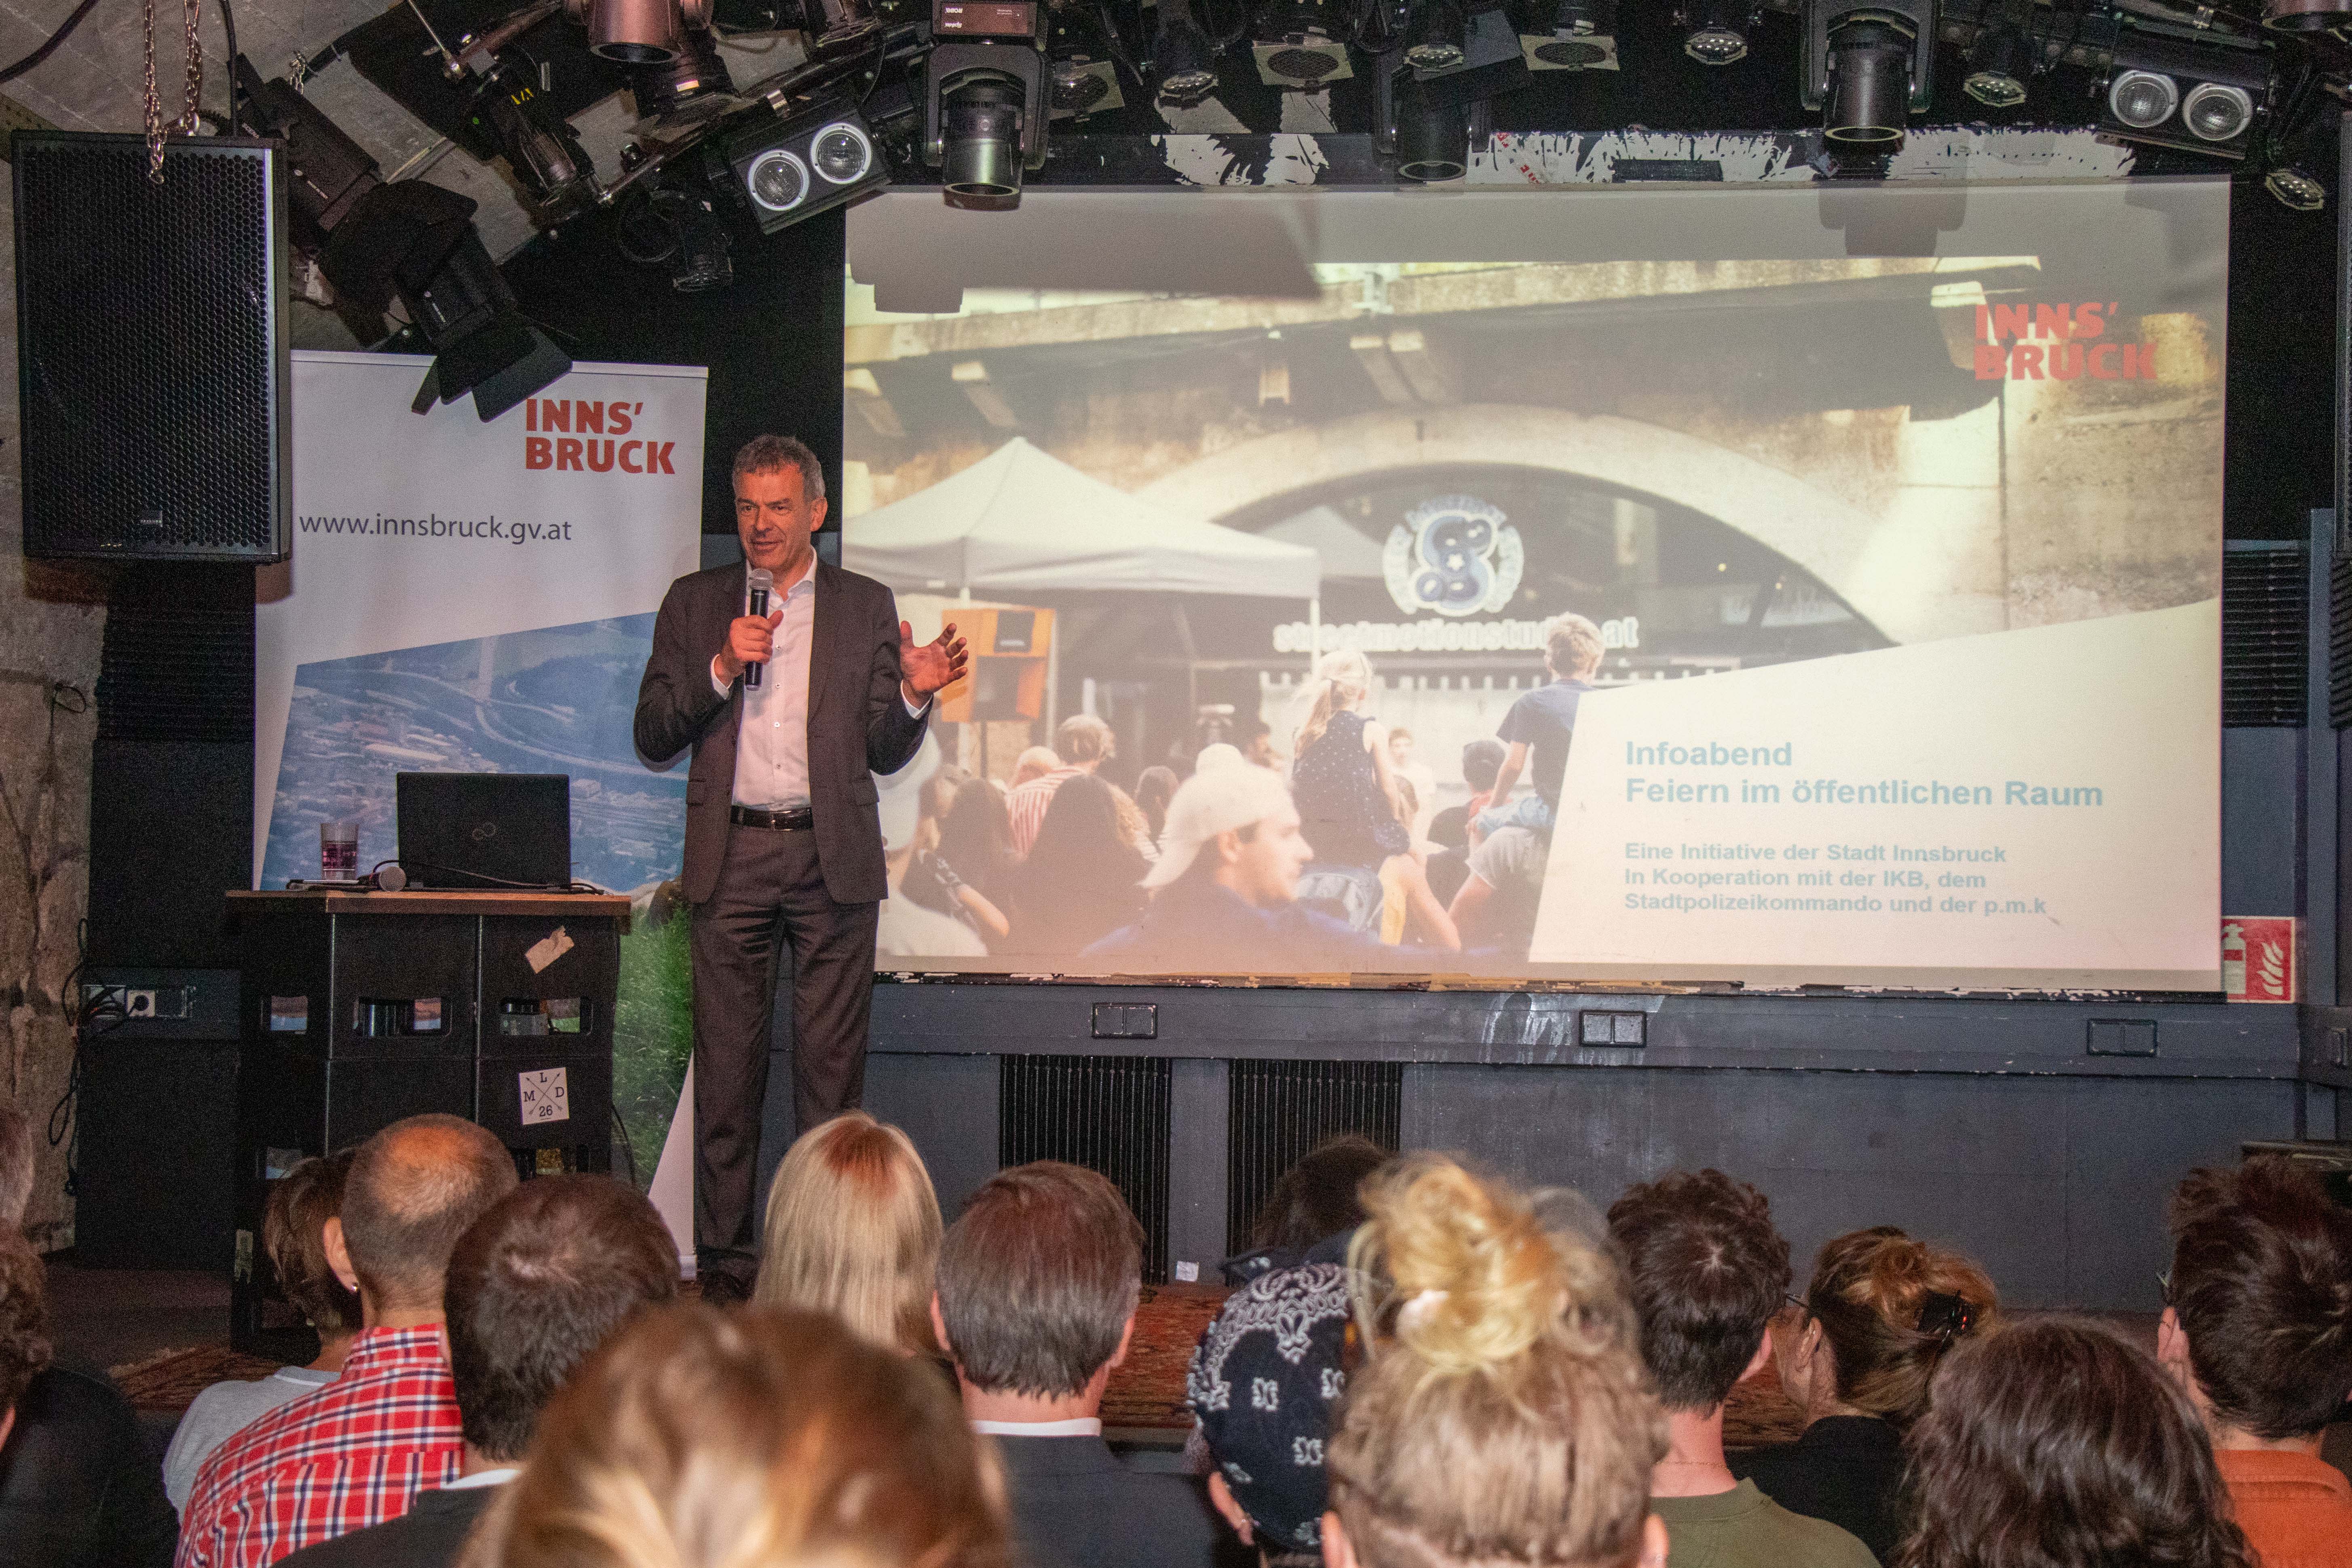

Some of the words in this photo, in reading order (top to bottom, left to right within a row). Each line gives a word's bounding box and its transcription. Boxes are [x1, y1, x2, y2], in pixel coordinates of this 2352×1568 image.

[1974, 343, 2157, 380] BRUCK
[526, 437, 675, 475] BRUCK
[299, 514, 572, 545] www.innsbruck.gv.at
[1626, 741, 1793, 766] Infoabend
[1626, 778, 1729, 803] Feiern
[1742, 779, 1780, 803] im
[1792, 779, 1993, 806] öffentlichen
[2004, 781, 2103, 806] Raum
[1625, 843, 1673, 859] Eine
[1681, 843, 1776, 860] Initiative
[1783, 844, 1819, 860] der
[1826, 844, 1885, 861] Stadt
[1893, 844, 2007, 863] Innsbruck
[1625, 869, 1644, 884] In
[1653, 869, 1789, 888] Kooperation
[1797, 870, 1833, 886] mit
[1839, 870, 1875, 887] der
[1883, 870, 1930, 890] IKB,
[1937, 871, 1987, 888] dem
[1625, 893, 1883, 914] Stadtpolizeikommando
[1889, 895, 1932, 913] und
[1940, 896, 1977, 914] der
[540, 1072, 547, 1083] L
[524, 1090, 536, 1102] M
[555, 1087, 565, 1097] D
[539, 1105, 553, 1116] 26
